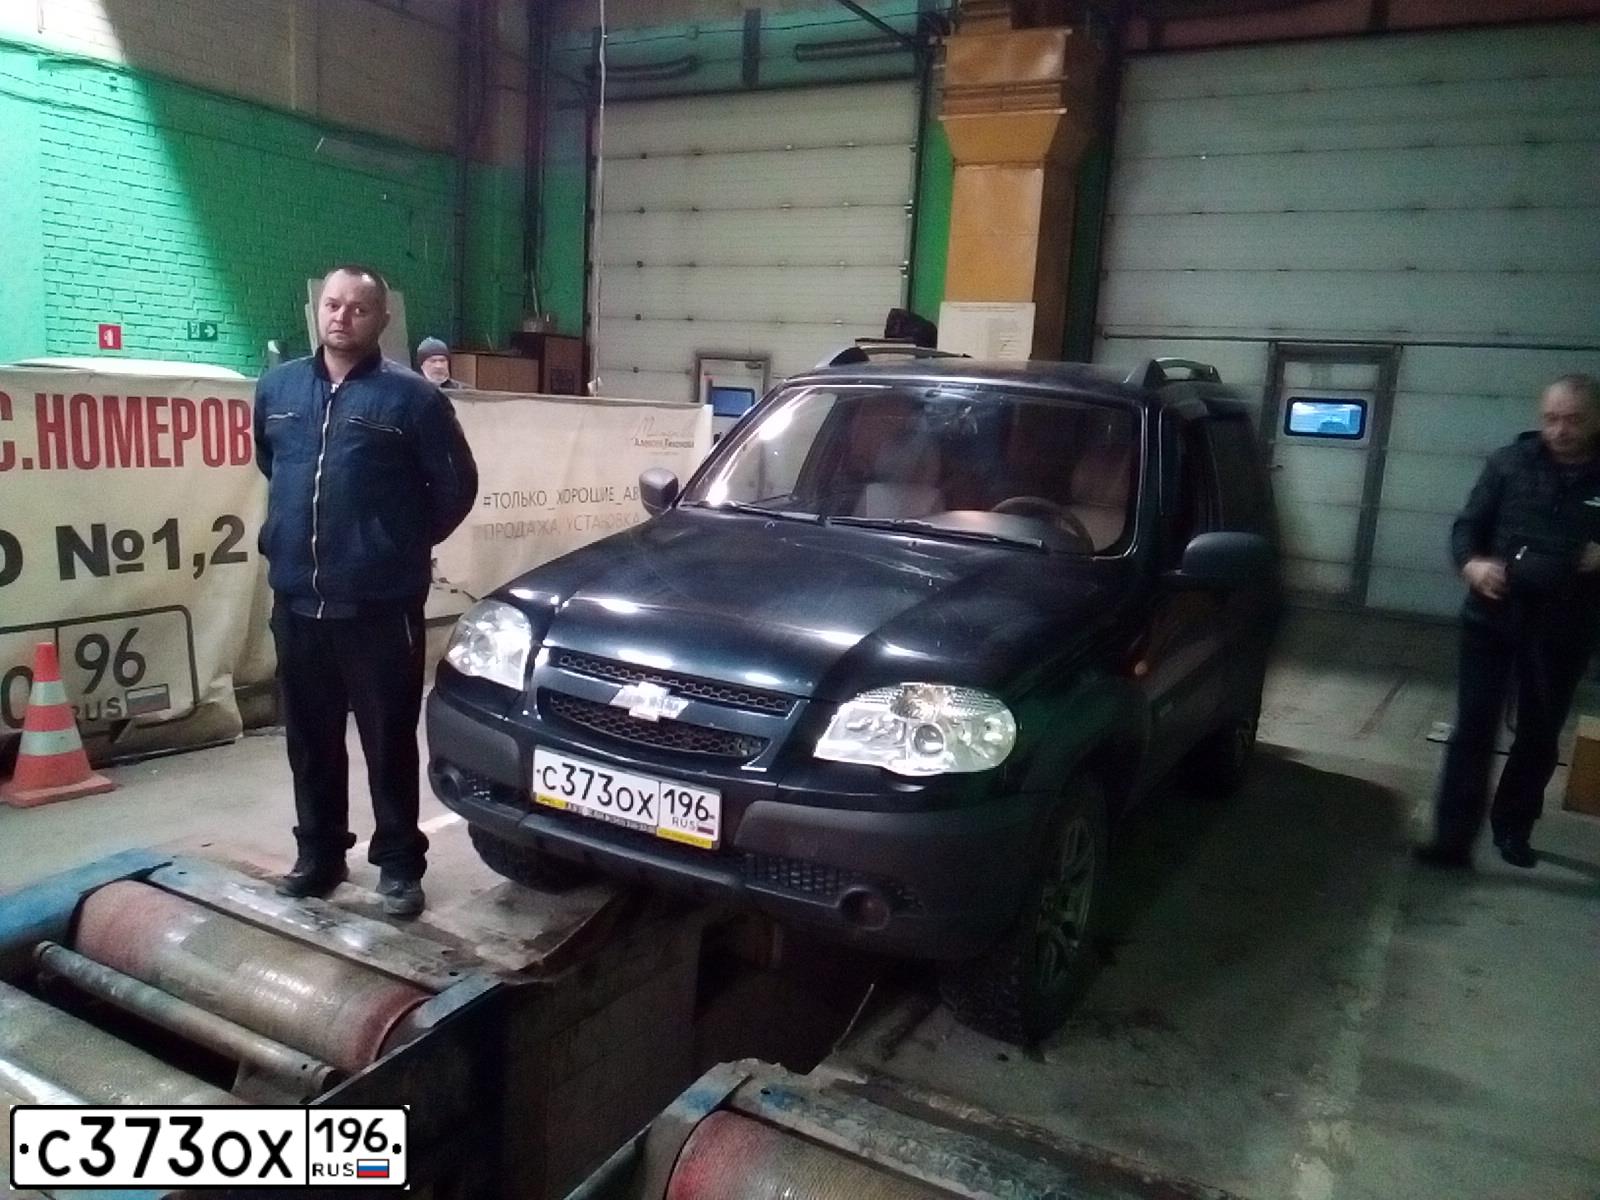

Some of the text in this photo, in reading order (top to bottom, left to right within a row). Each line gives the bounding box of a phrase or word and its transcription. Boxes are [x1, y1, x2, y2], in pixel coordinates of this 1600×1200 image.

[55, 515, 248, 581] №1,2
[74, 628, 146, 694] 96
[542, 762, 654, 819] С373ОХ
[663, 788, 710, 822] 196
[672, 816, 696, 831] RUS
